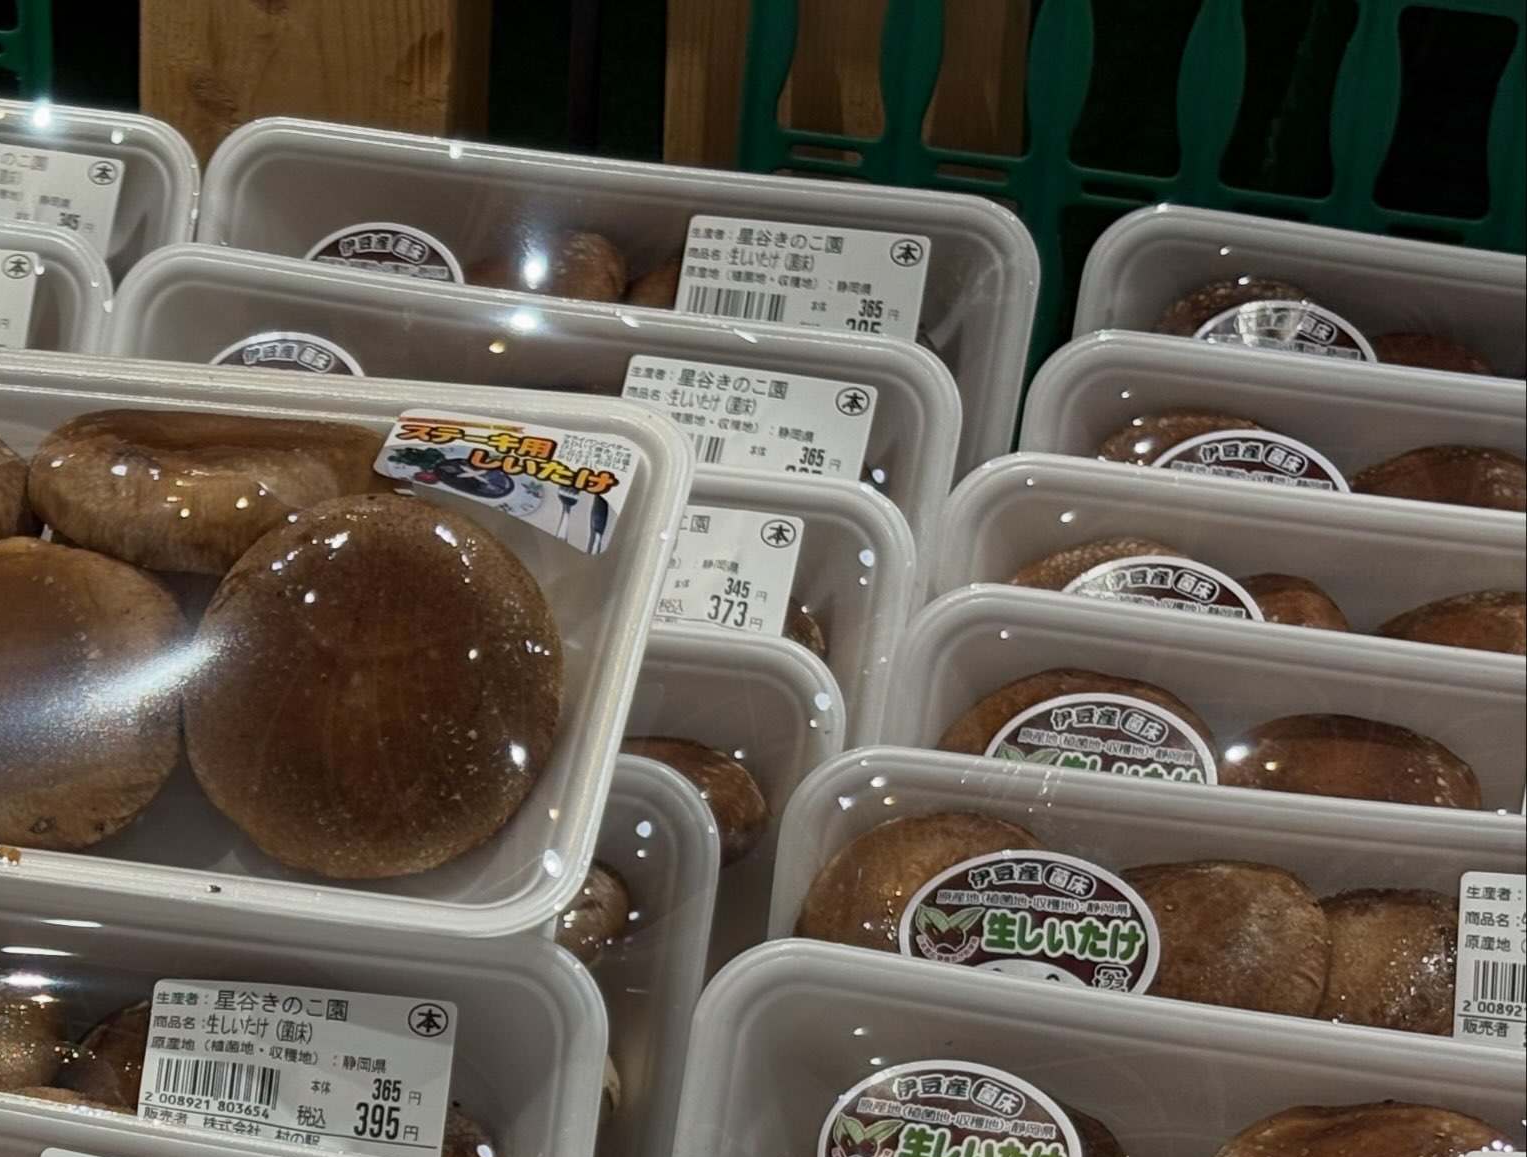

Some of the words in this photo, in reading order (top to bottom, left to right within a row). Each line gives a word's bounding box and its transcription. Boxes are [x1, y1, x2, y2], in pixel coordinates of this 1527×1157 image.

[396, 424, 558, 460] ステーキ用
[468, 447, 619, 494] しいたけ
[969, 863, 1042, 888] 伊豆産
[983, 910, 1144, 963] 生しいたけ
[894, 1074, 971, 1100] 伊豆産
